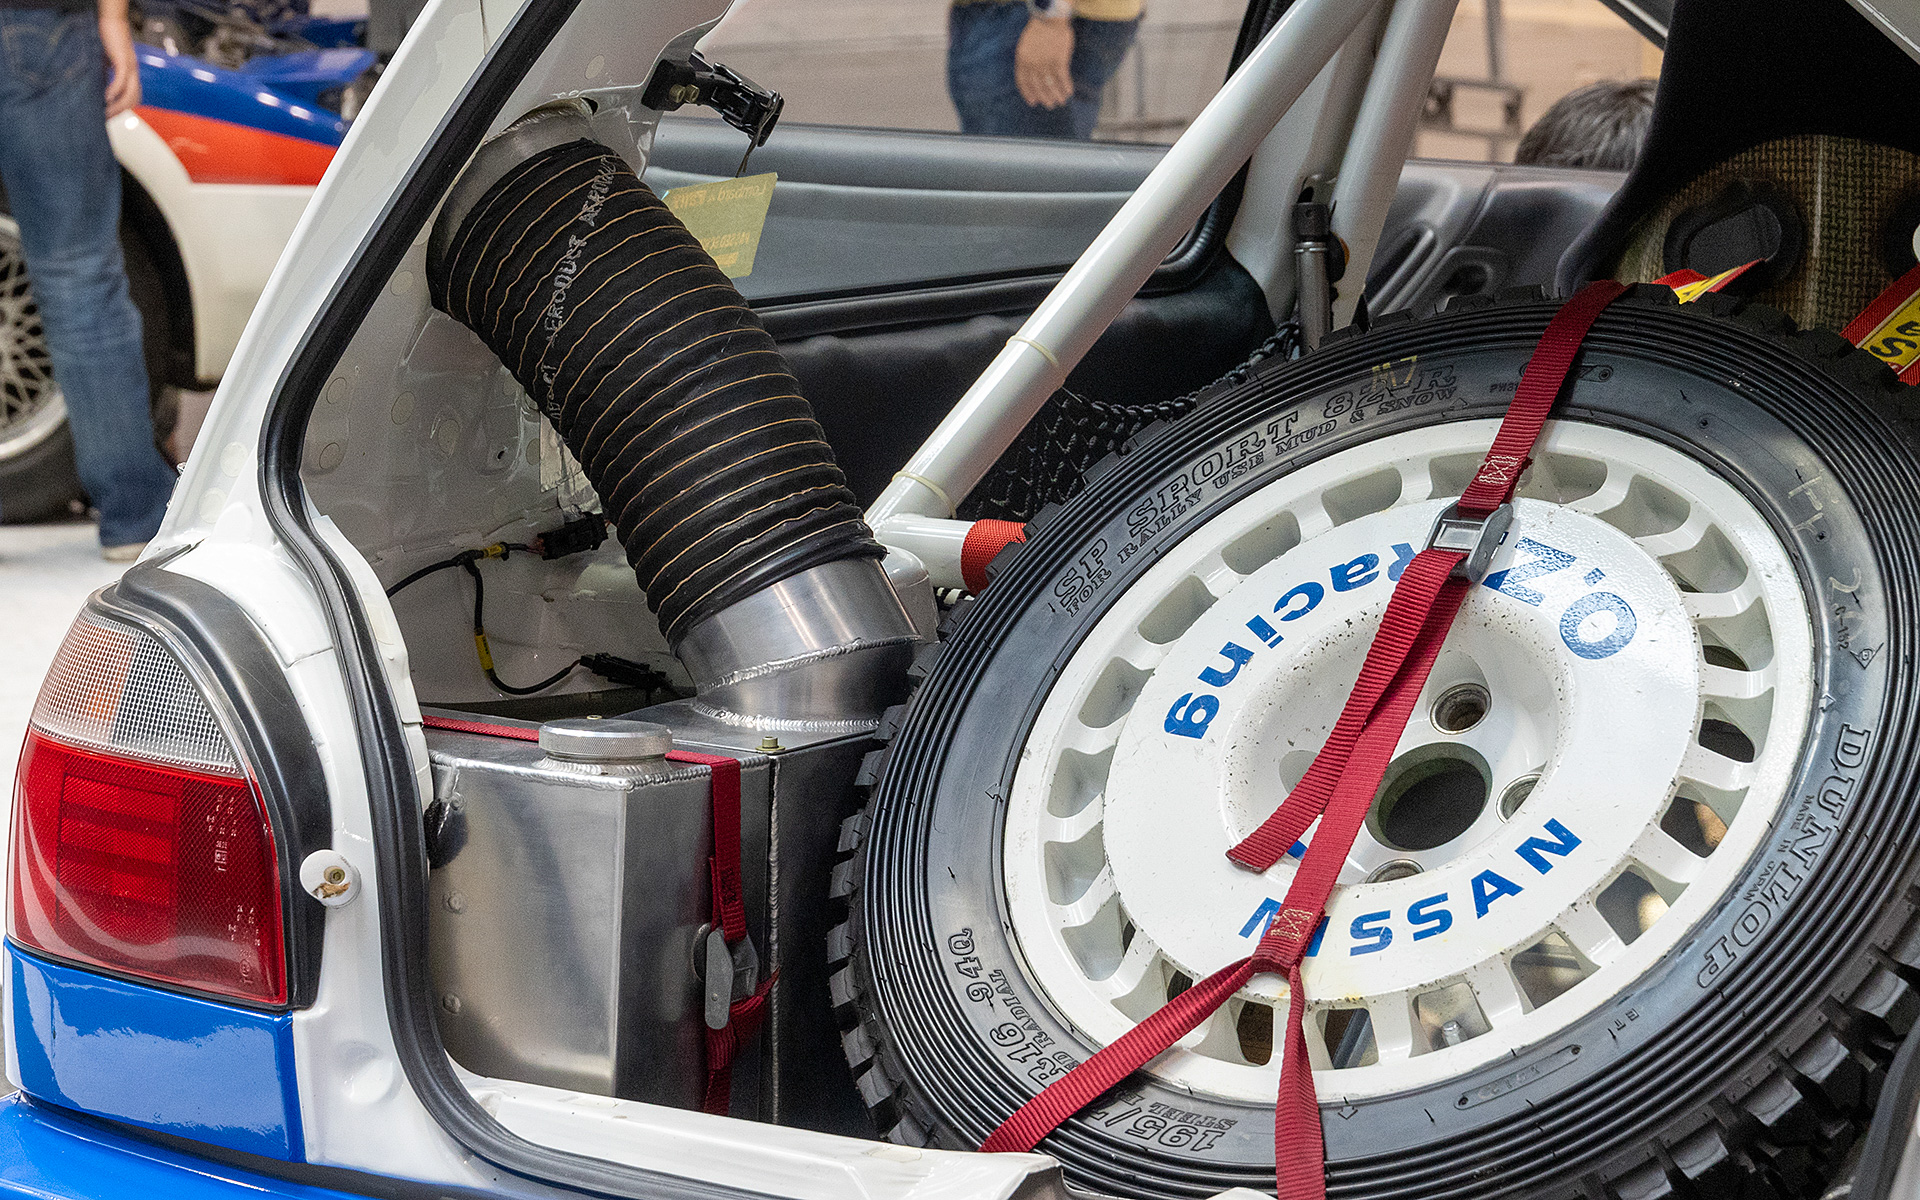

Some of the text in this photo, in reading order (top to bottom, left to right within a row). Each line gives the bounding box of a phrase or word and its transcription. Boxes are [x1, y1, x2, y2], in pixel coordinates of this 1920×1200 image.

[1054, 538, 1109, 608] SP
[1126, 410, 1299, 538] SPORT
[1066, 386, 1457, 617] FOR RALLY USE MUD & SNOW
[1697, 723, 1871, 988] DUNLOP
[1743, 794, 1814, 902] MADE IN JAPAN
[989, 969, 1239, 1131] STEEL RADIAL
[990, 1023, 1067, 1089] R16
